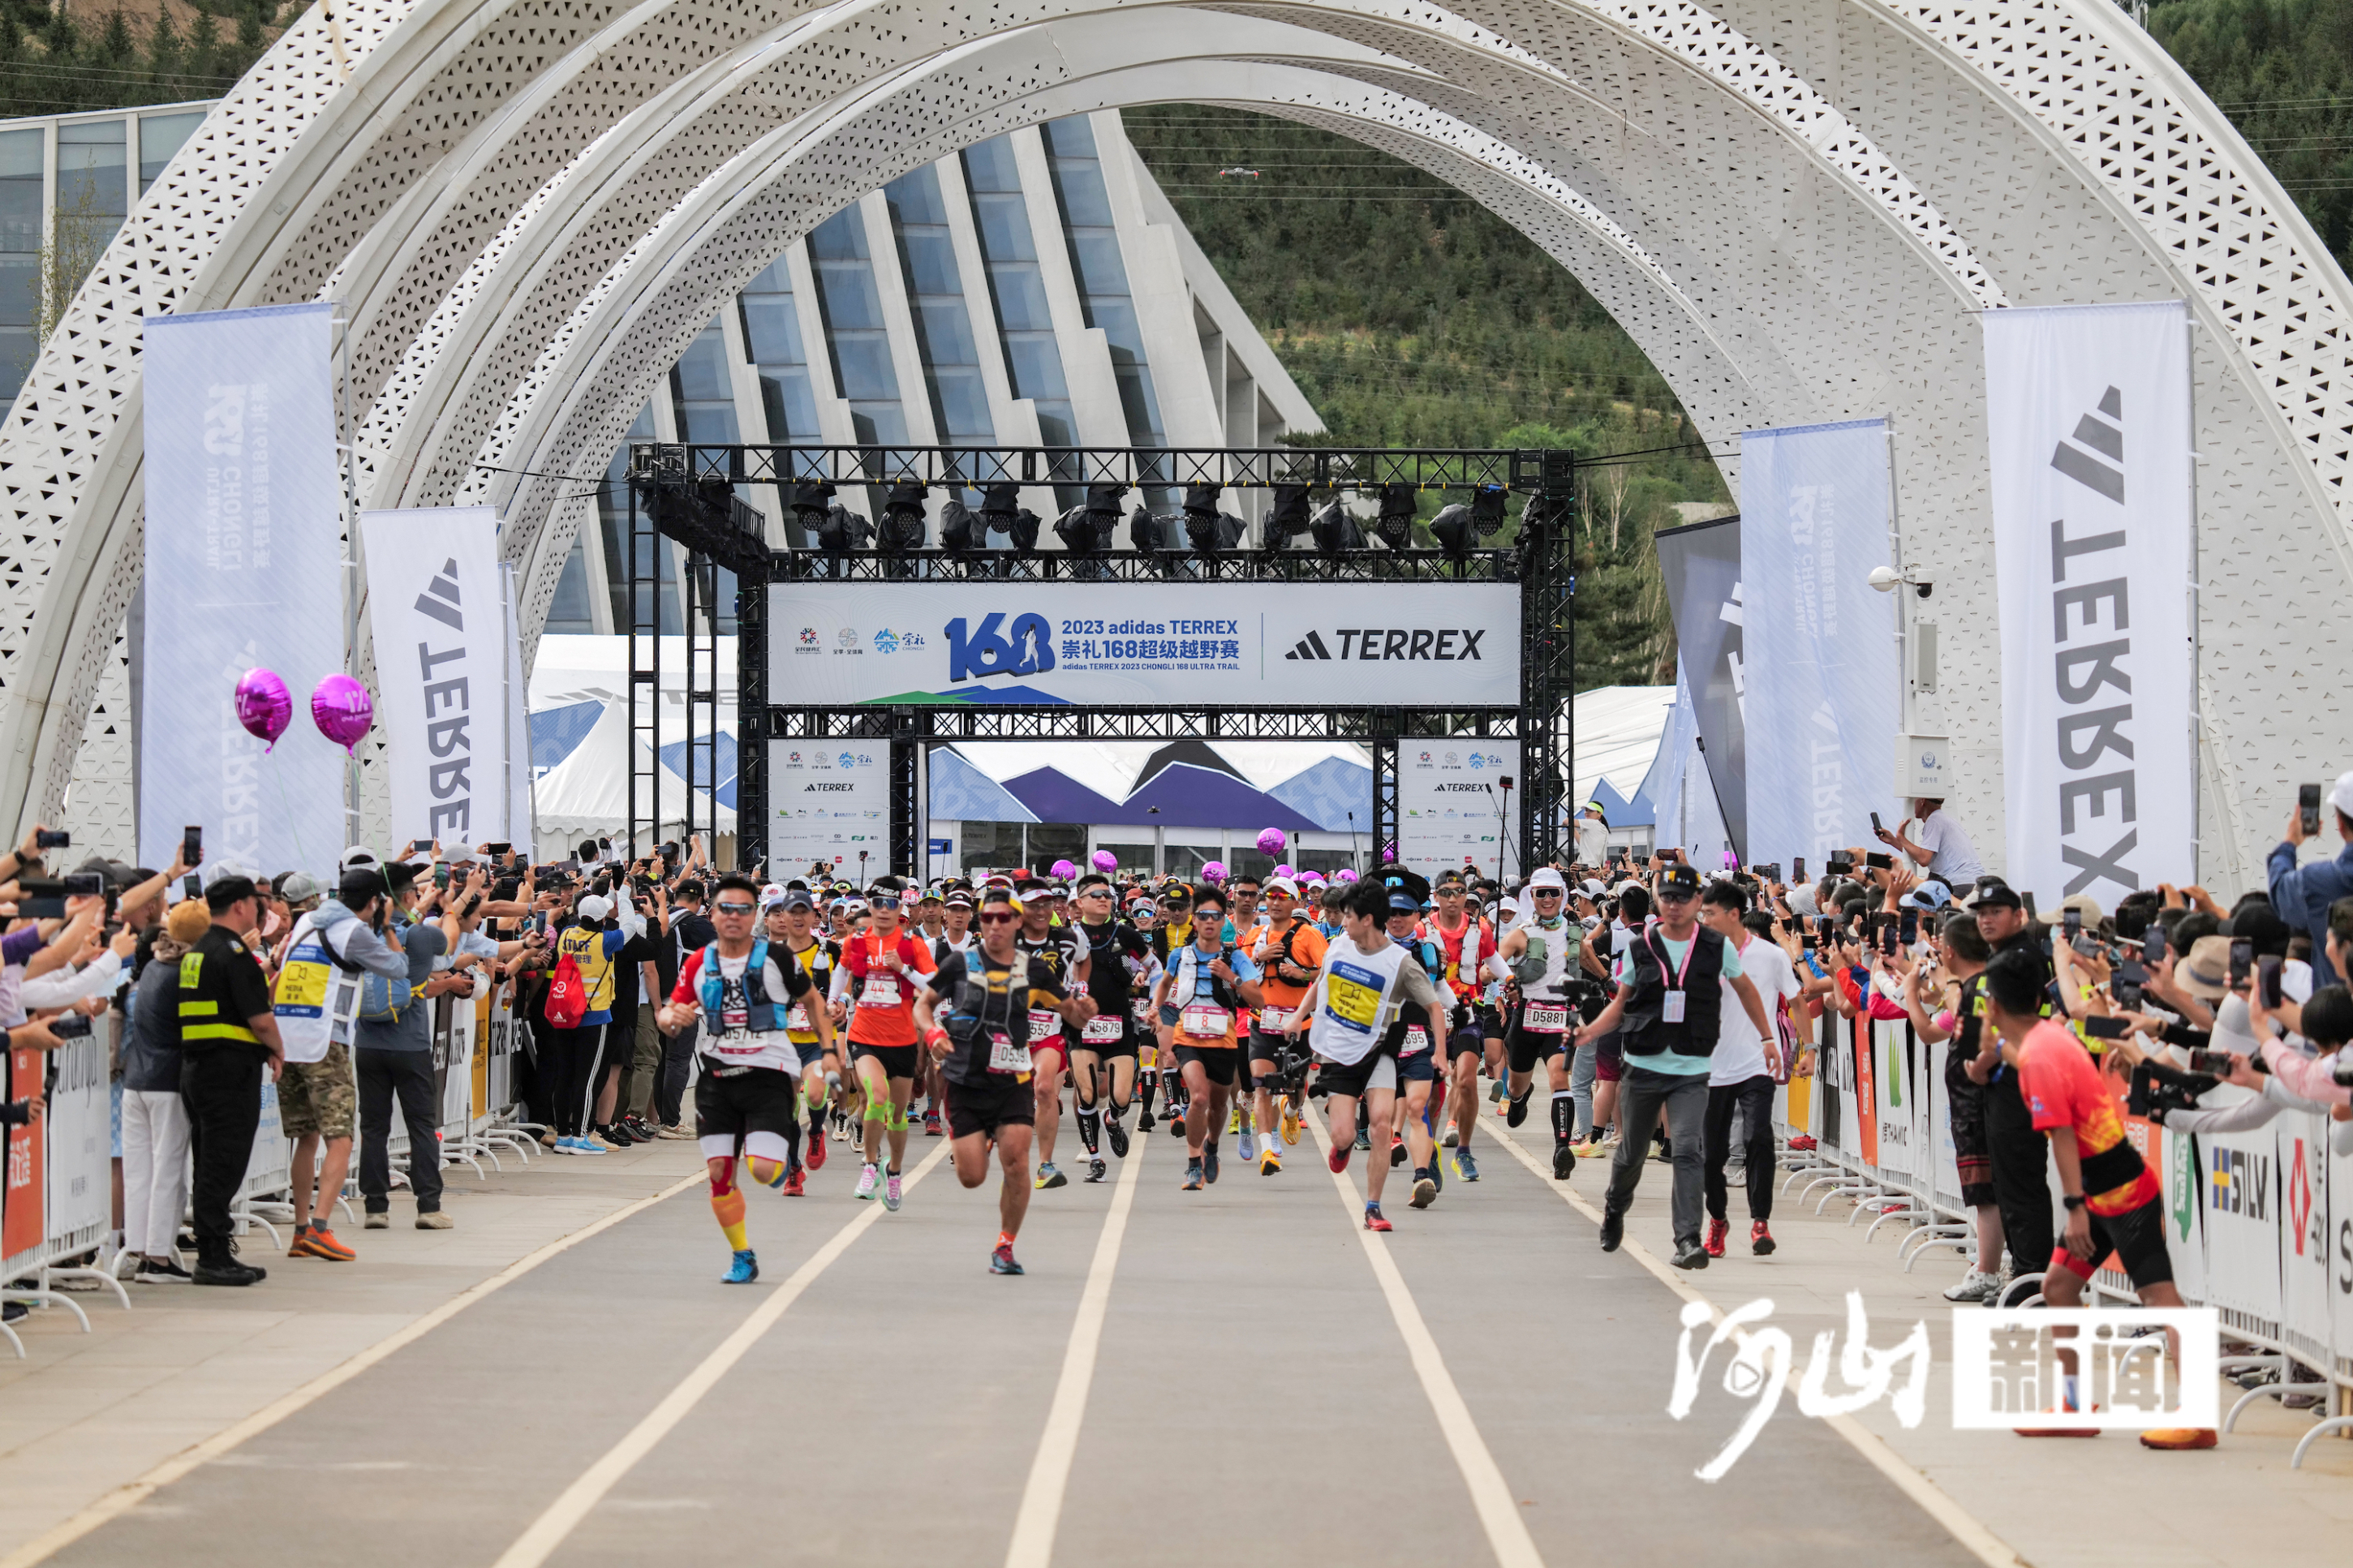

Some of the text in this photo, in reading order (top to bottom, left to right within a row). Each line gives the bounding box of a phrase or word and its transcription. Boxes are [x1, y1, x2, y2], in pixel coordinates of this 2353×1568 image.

[1062, 620, 1238, 634] 2023 adidas TERREX
[902, 632, 925, 646] 崇礼
[1336, 629, 1486, 660] TERREX
[944, 612, 1055, 682] 168
[1062, 639, 1240, 659] 崇礼168超级越野赛
[817, 783, 854, 792] TERREX
[1447, 784, 1484, 792] TERREX
[871, 884, 900, 898] FUGA
[562, 939, 591, 952] STAFF
[871, 982, 885, 995] 44
[1338, 998, 1356, 1011] MEDIA
[1202, 1015, 1208, 1027] 8
[1277, 1013, 1284, 1024] 7
[1533, 1011, 1564, 1024] D5881
[1030, 1023, 1050, 1036] 552
[1089, 1021, 1120, 1033] D5879
[1402, 1033, 1425, 1045] 695
[2231, 1149, 2269, 1222] SILV
